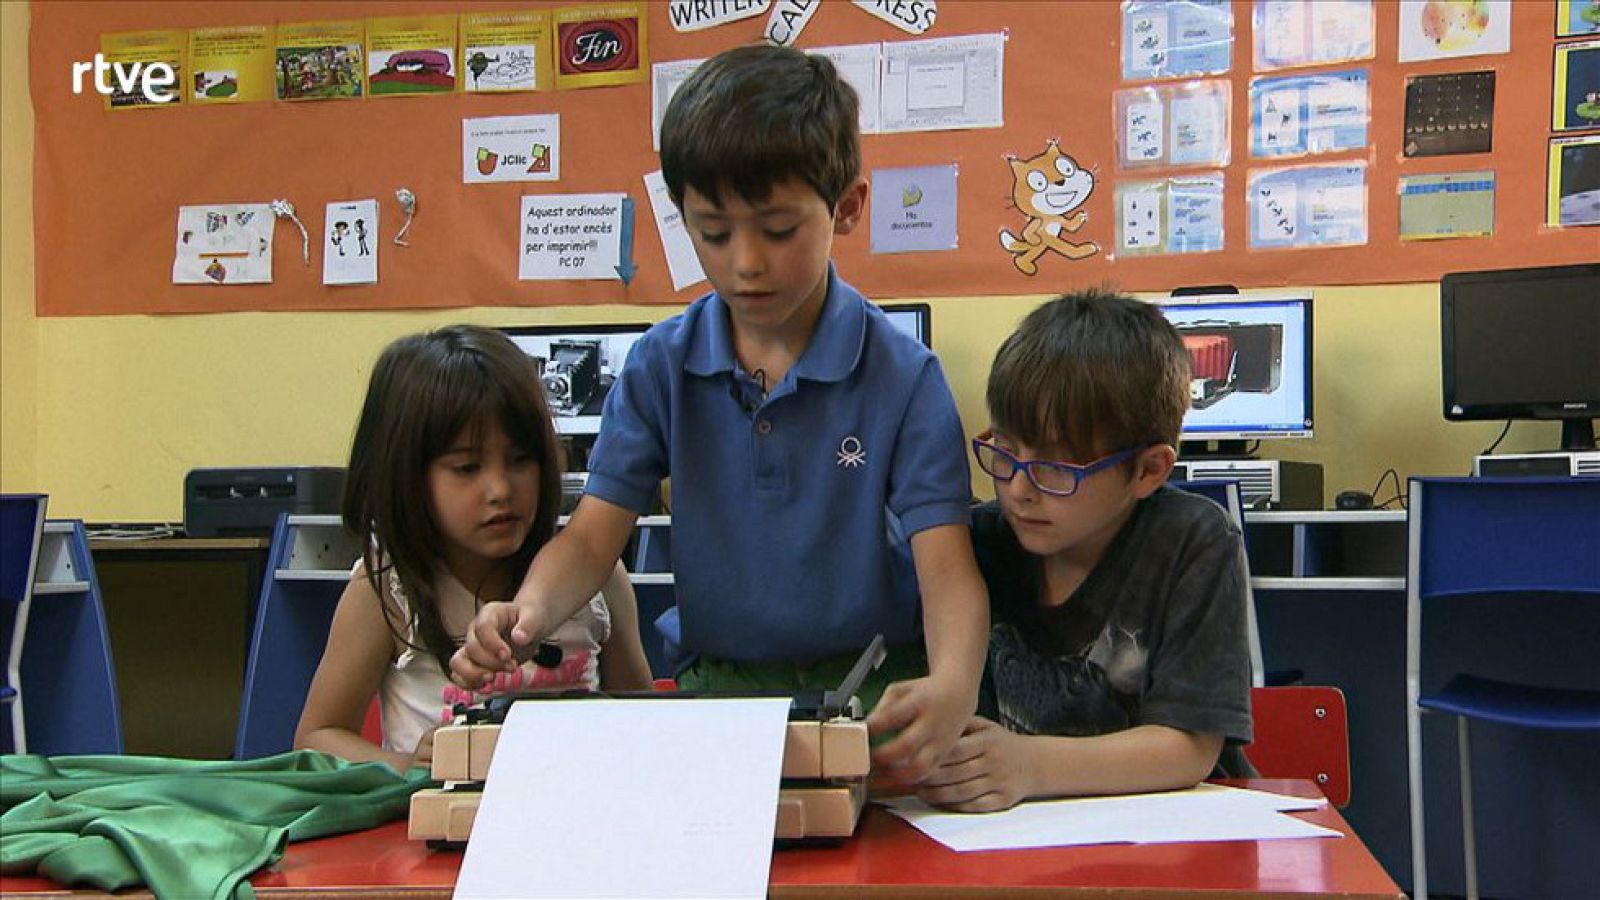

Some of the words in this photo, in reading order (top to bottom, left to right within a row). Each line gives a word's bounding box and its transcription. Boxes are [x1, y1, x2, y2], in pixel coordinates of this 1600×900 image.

[572, 30, 623, 65] Fin
[500, 154, 528, 166] JClic
[527, 206, 564, 219] Aquest
[566, 204, 618, 216] ordinador
[526, 223, 540, 235] ha
[542, 222, 581, 235] d'estar
[582, 221, 613, 234] encès
[525, 242, 544, 255] per
[559, 257, 571, 267] PC
[572, 257, 586, 267] 07
